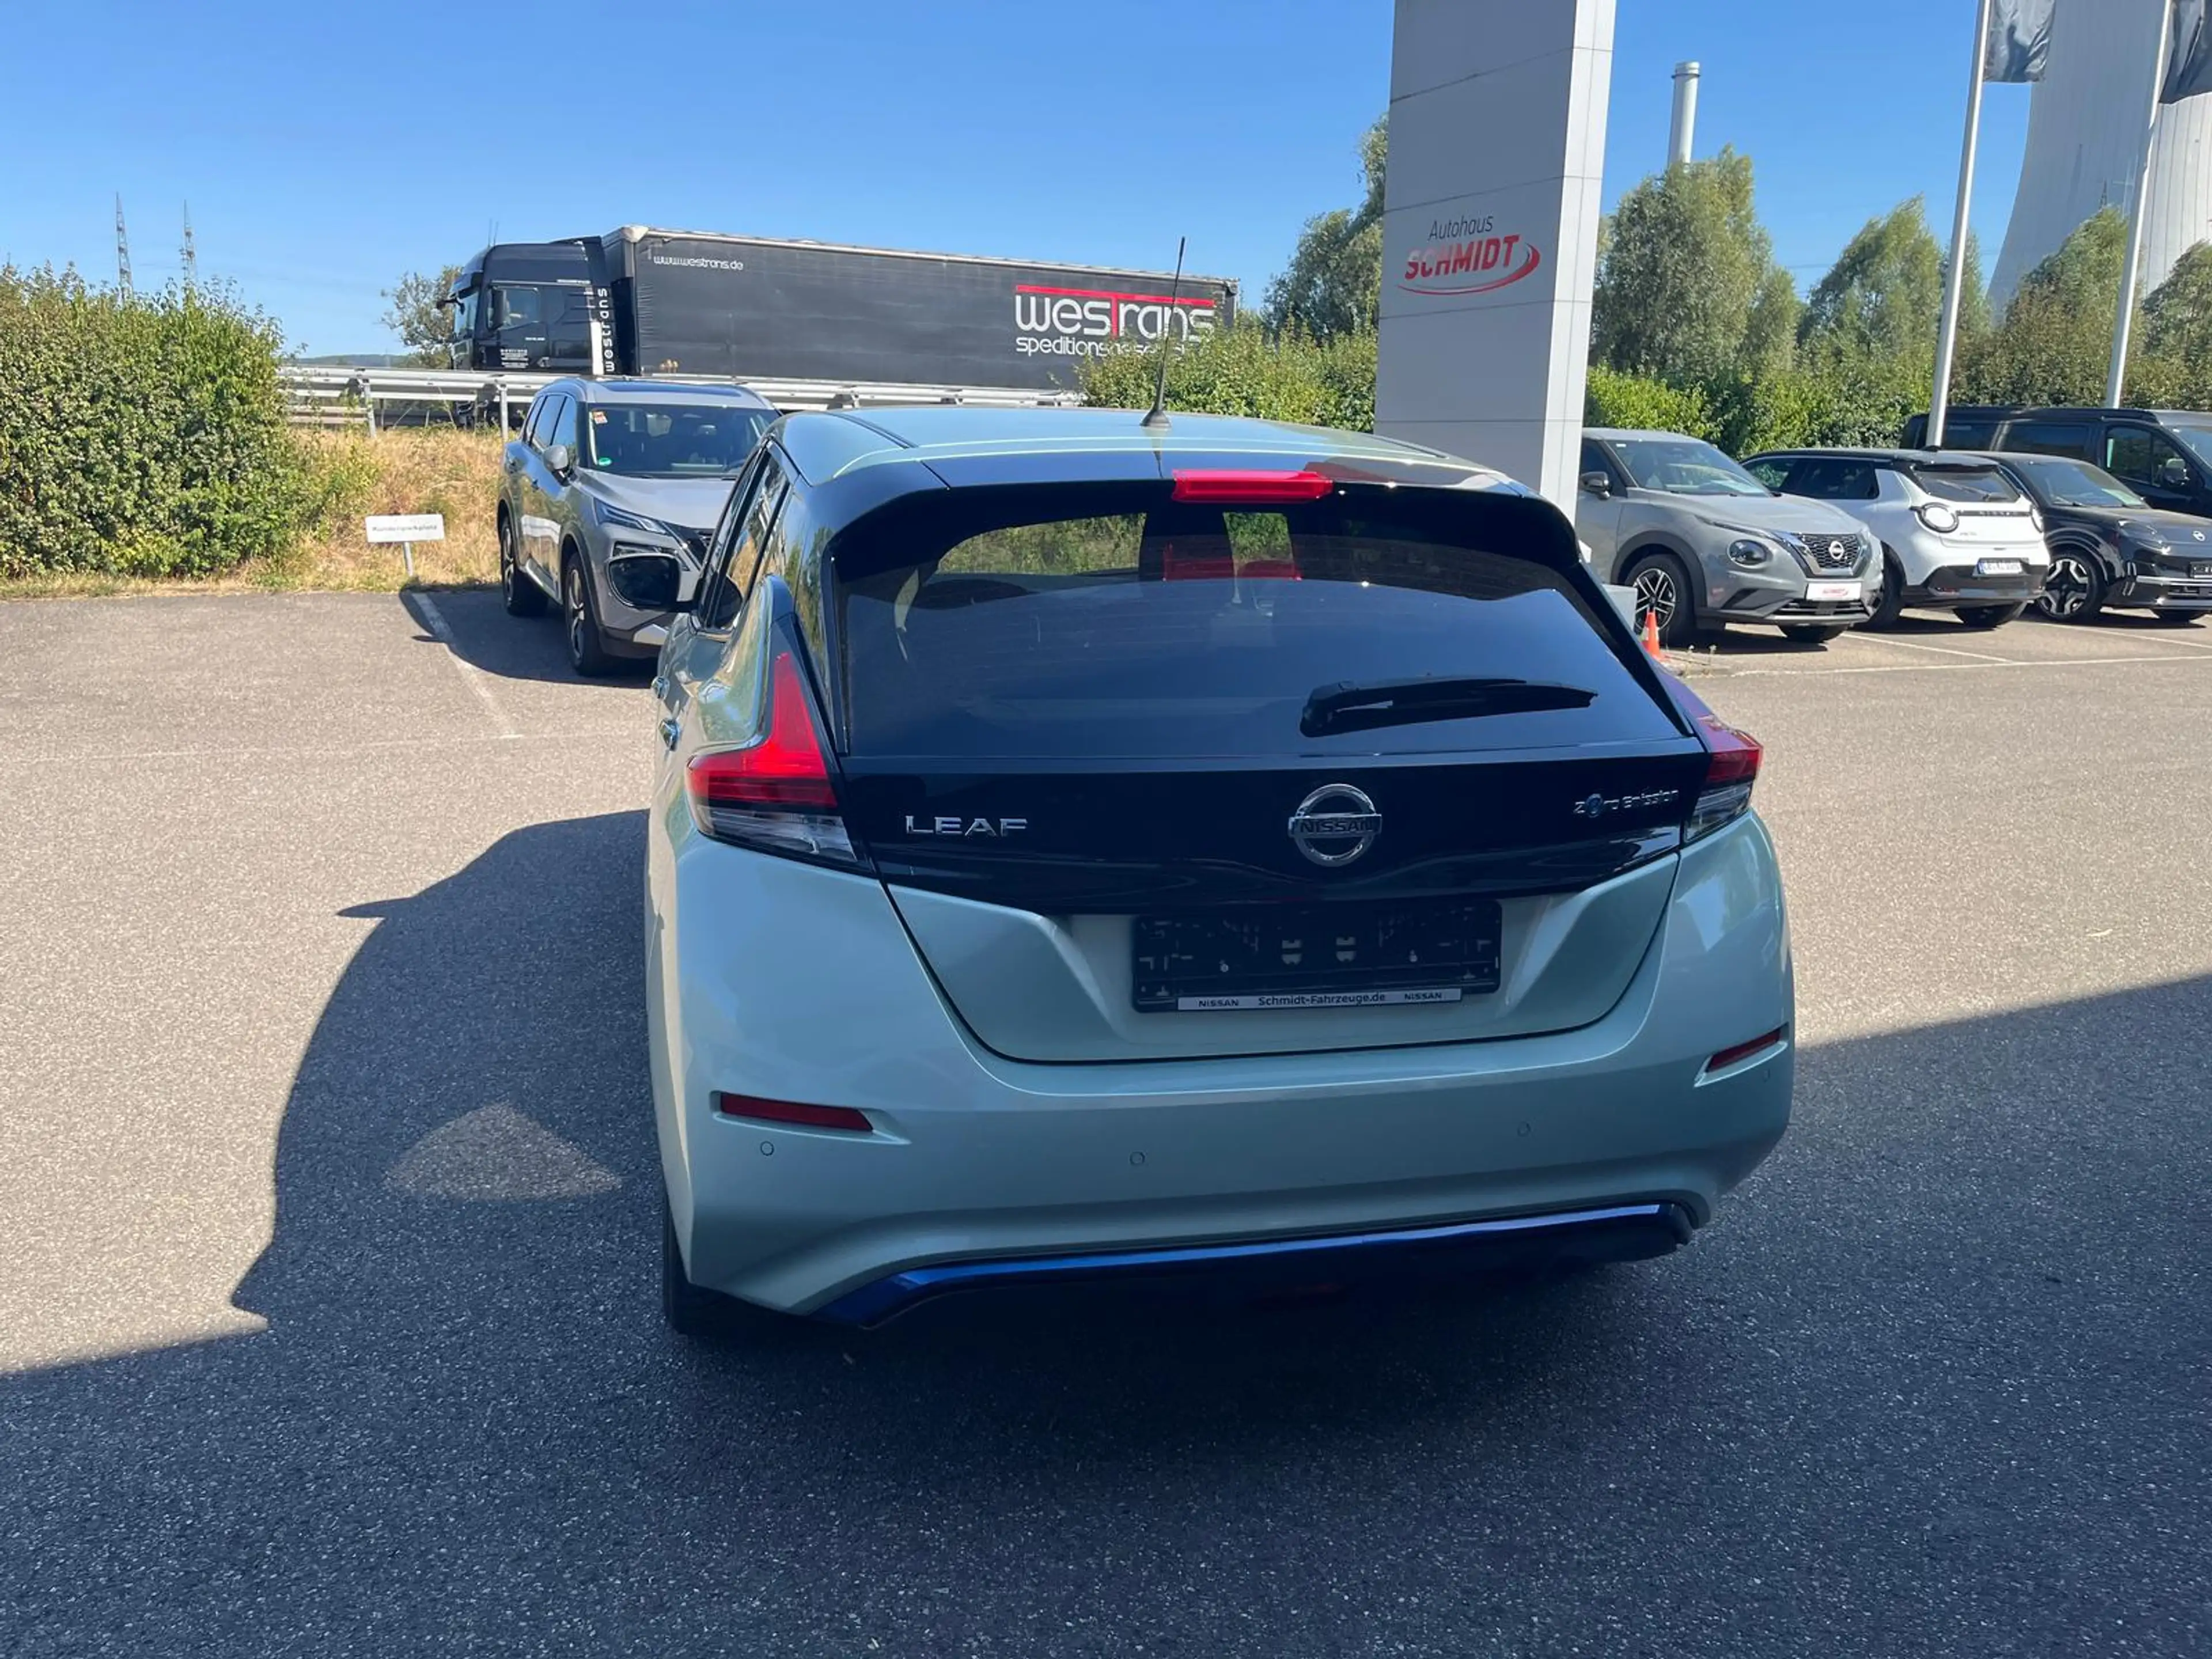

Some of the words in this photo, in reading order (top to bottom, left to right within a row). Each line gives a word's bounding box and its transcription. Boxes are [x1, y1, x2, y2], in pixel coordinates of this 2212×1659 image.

[1427, 215, 1494, 240] Autohaus
[653, 255, 744, 271] www.westrans.de
[1404, 234, 1520, 280] SCHMIDT
[597, 287, 615, 373] westrans
[905, 815, 1028, 836] LEAF
[1300, 819, 1374, 834] NISSAN
[1198, 998, 1239, 1007] NISSAN
[1258, 991, 1385, 1006] Schmidt-Fahrzeuge.de
[1404, 992, 1442, 1001] NISSAN
